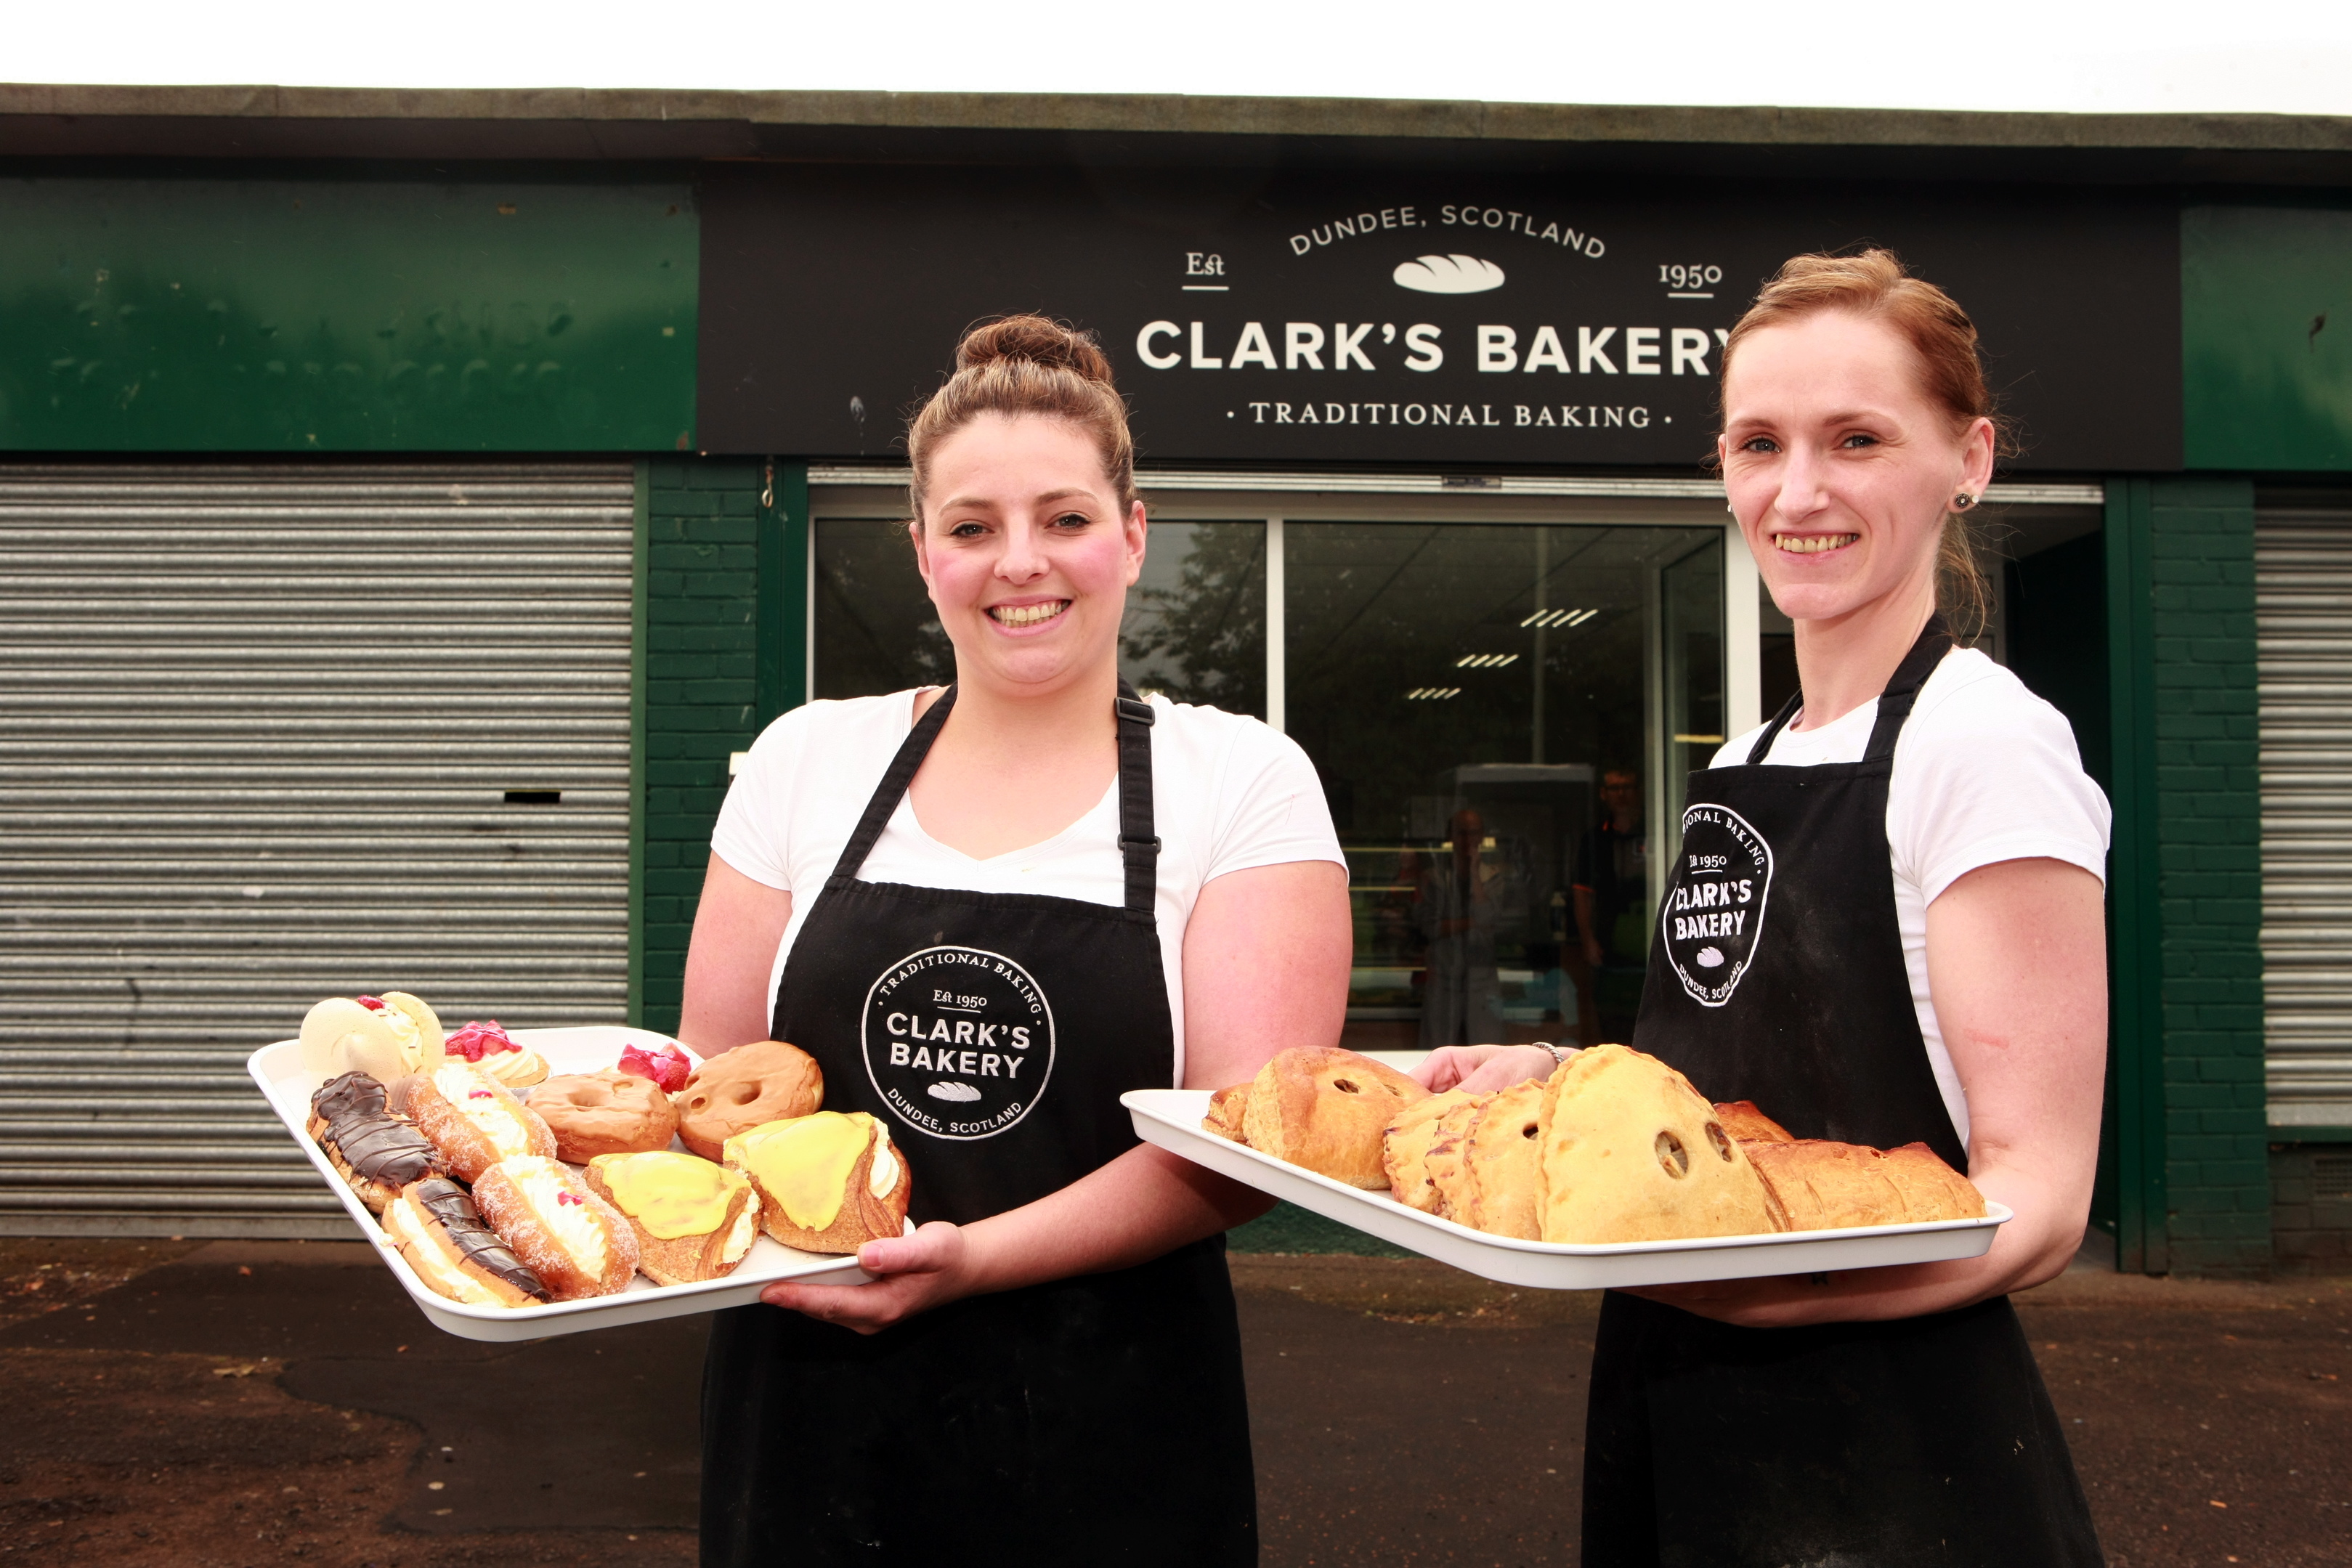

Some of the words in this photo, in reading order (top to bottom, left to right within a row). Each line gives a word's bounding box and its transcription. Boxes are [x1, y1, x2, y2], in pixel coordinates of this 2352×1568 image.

[1289, 206, 1427, 256] DUNDEE,
[1442, 206, 1605, 259] SCOTLAND
[1186, 252, 1225, 276] Est
[1660, 264, 1722, 289] 1950
[1136, 320, 1444, 373] CLARK'S
[1477, 325, 1729, 375] BAKER
[1249, 402, 1500, 426] TRADITIONAL
[1514, 405, 1650, 428] BAKING
[1683, 810, 1721, 836] IONAL
[1725, 816, 1765, 866] BAKING
[1699, 855, 1727, 868] 1950
[1676, 879, 1752, 911] CLARK'S
[1675, 909, 1746, 941] BAKERY
[880, 953, 989, 996] TRADITIONAL
[993, 962, 1042, 1015] BAKING
[1679, 963, 1709, 1000] DUNDEE,
[1711, 960, 1743, 999] SCOTLAND
[933, 989, 952, 1003] Est
[956, 995, 987, 1009] 1950
[886, 1012, 1030, 1050] CLARK'S
[890, 1041, 1025, 1078] BAKERY
[887, 1088, 943, 1133] DUNDEE,
[949, 1102, 1021, 1134] SCOTLAND
